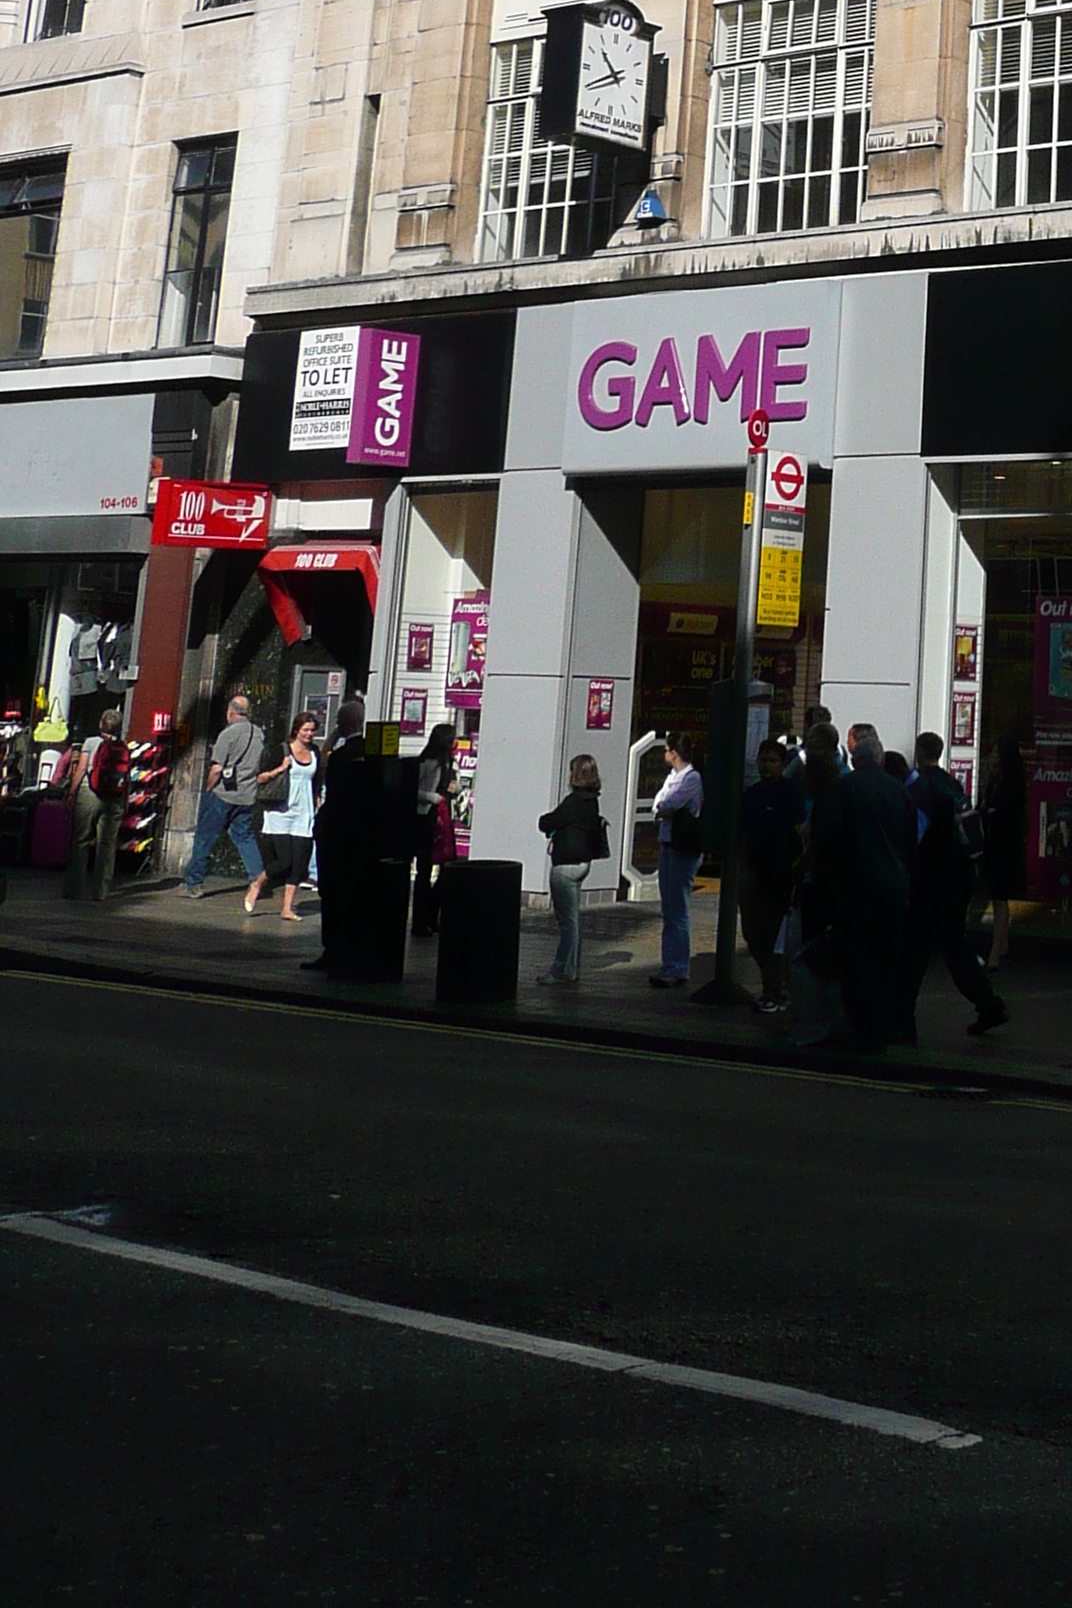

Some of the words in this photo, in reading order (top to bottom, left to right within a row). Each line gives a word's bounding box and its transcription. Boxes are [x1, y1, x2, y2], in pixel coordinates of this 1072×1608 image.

[603, 8, 633, 31] 100
[578, 108, 611, 125] ALFRED
[612, 117, 642, 133] MARKS
[315, 332, 344, 344] SUPERB
[303, 343, 354, 357] REFURBISHED
[303, 357, 329, 368] OFFICE
[329, 355, 352, 366] SUITE
[300, 369, 320, 387] TO
[323, 367, 353, 385] LET
[578, 327, 811, 431] GAME
[302, 389, 313, 398] ALL
[314, 387, 346, 397] ENQUIRIES
[374, 339, 408, 447] GAME
[293, 422, 308, 435] 020
[309, 421, 329, 434] 7629
[330, 420, 350, 432] 0811
[753, 420, 767, 437] OL
[178, 490, 205, 521] 100
[171, 522, 205, 536] CLUB
[454, 602, 490, 614] Amazin
[1040, 600, 1067, 616] Out
